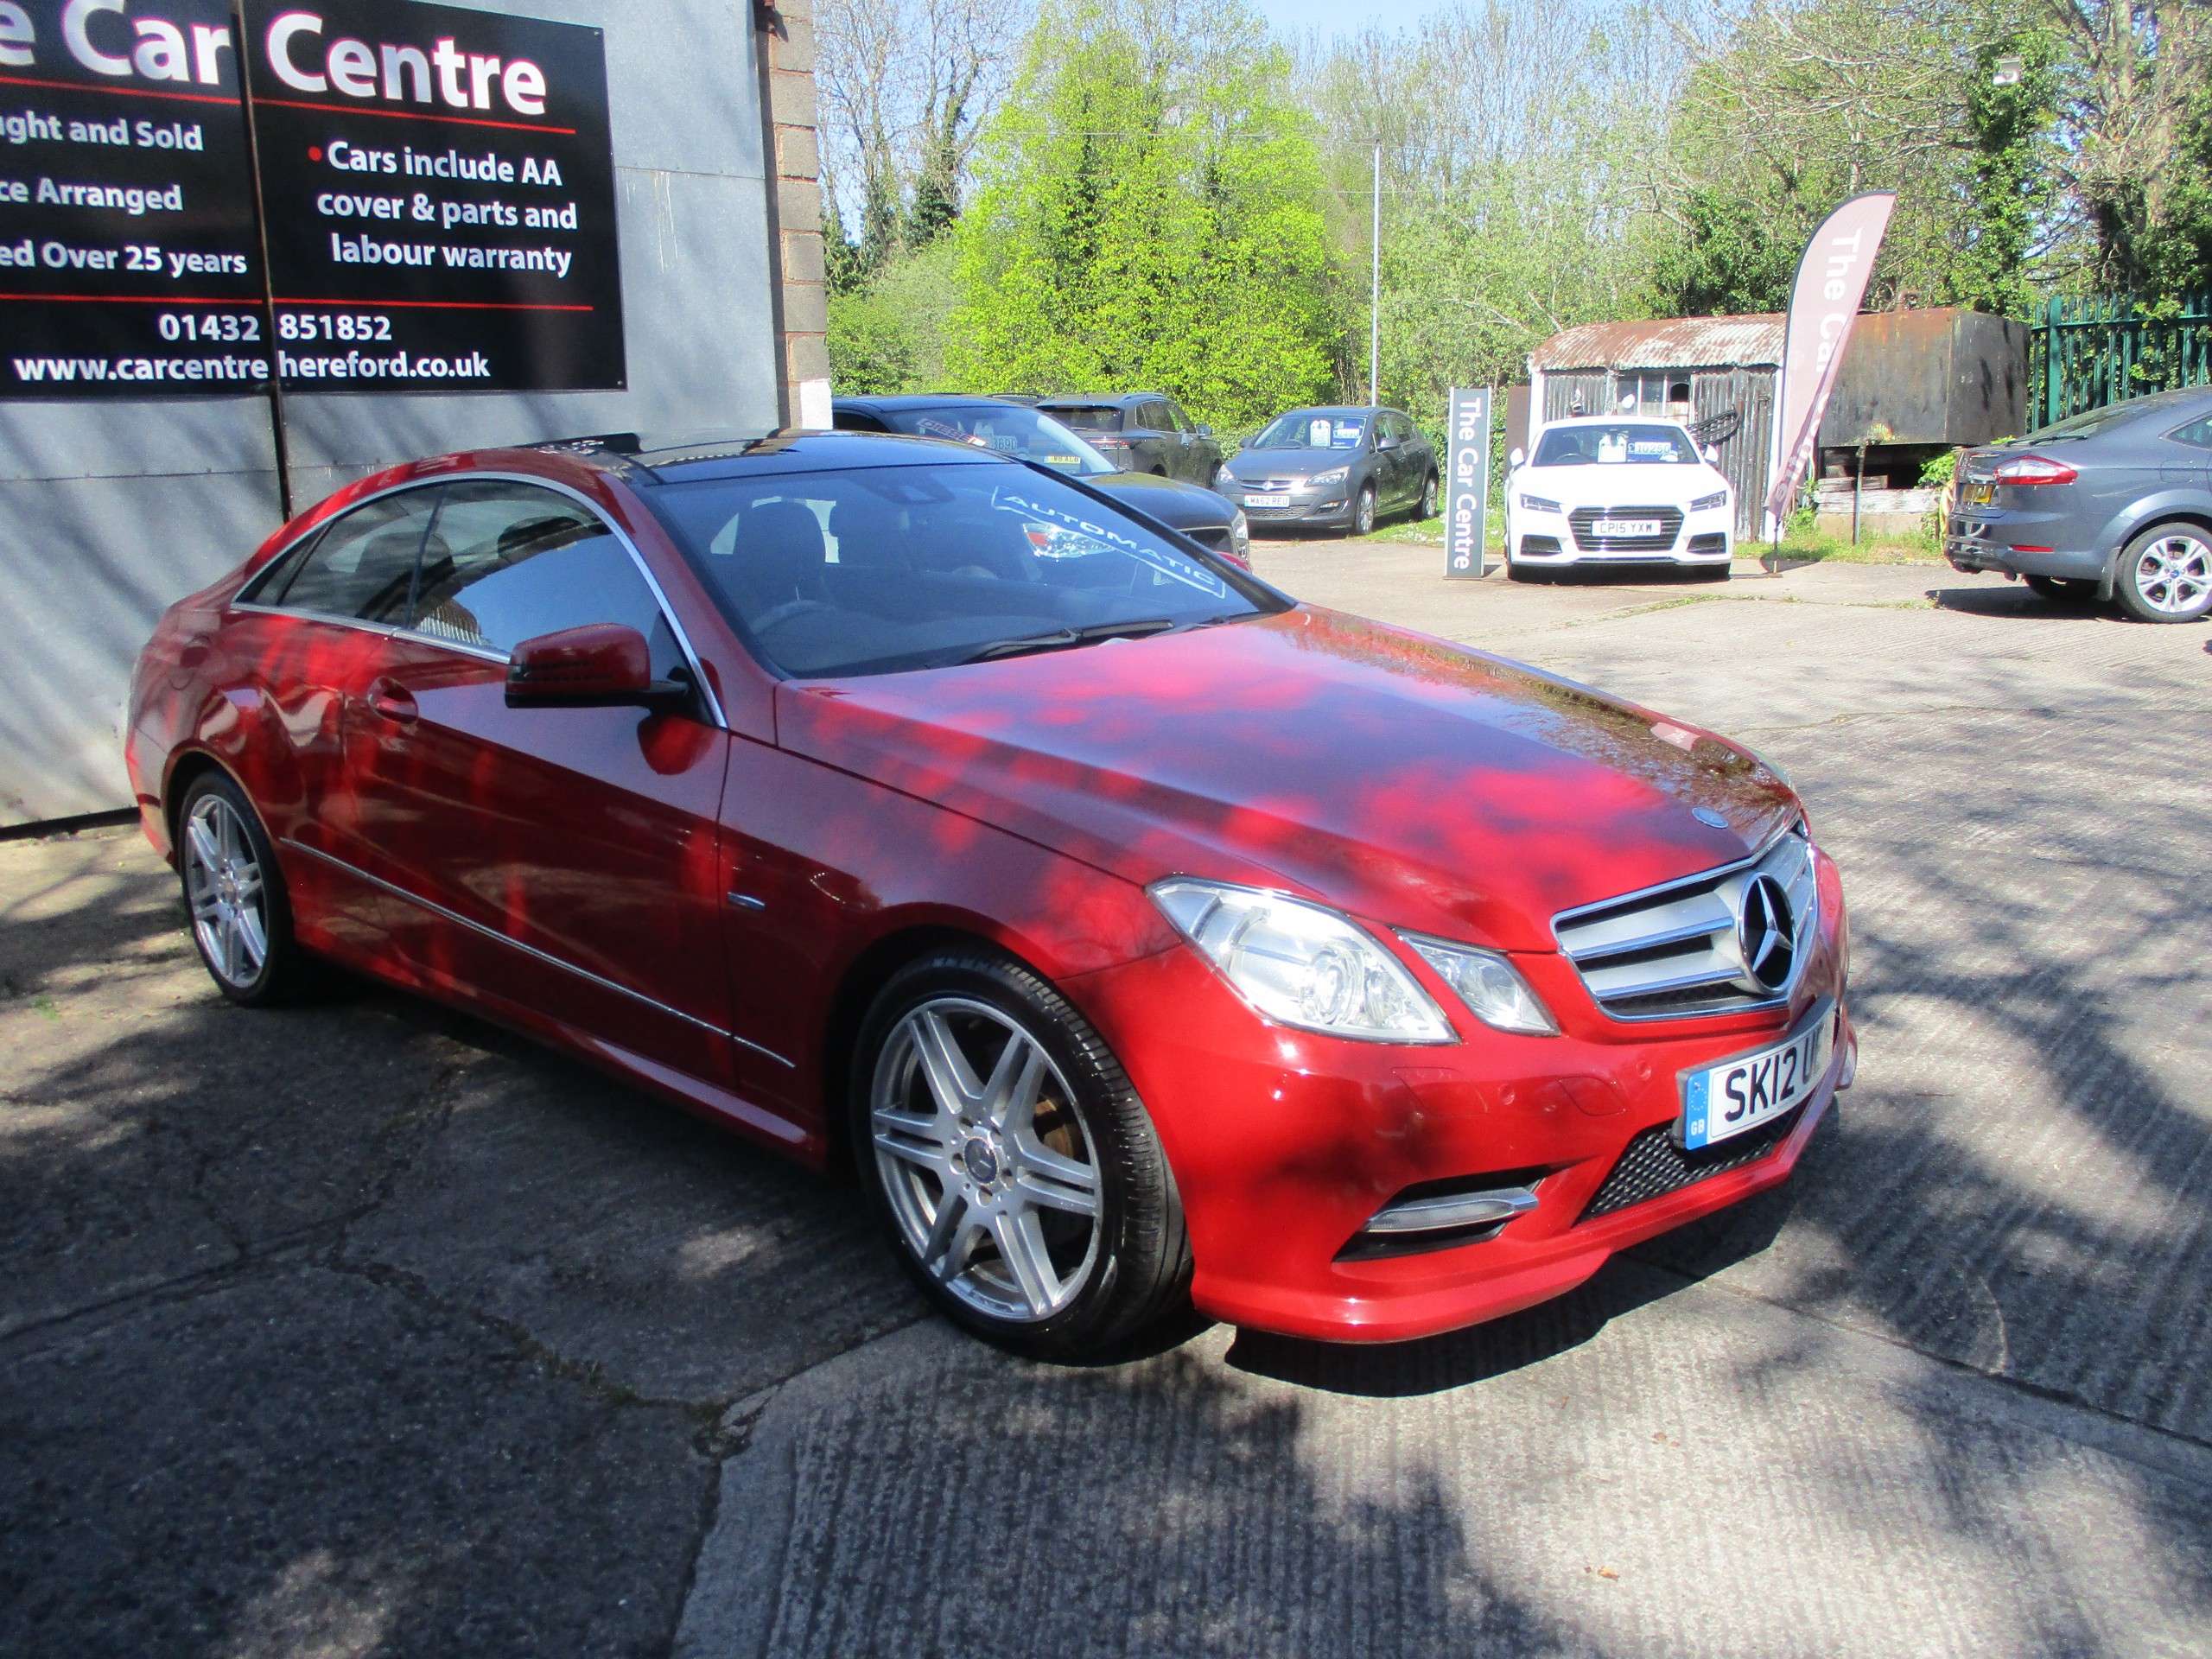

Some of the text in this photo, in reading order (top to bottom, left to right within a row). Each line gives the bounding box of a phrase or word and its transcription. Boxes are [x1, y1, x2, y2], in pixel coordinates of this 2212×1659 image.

[62, 0, 232, 85] Car
[267, 11, 547, 115] Centre
[69, 118, 130, 146] and
[137, 121, 204, 152] Sold
[327, 141, 563, 187] Cars include AA
[37, 177, 184, 215] Arranged
[317, 193, 578, 230] cover & parts and
[42, 242, 118, 270] Over
[124, 246, 162, 271] 25
[170, 251, 248, 278] years
[332, 232, 572, 278] labour warranty
[1823, 228, 1863, 301] The
[159, 314, 392, 341] 01432 851852
[1453, 397, 1482, 569] The Car Centre
[1004, 496, 1216, 587] AUTOMATIC
[1724, 1046, 1798, 1122] SK12
[1691, 1120, 1706, 1136] GB
